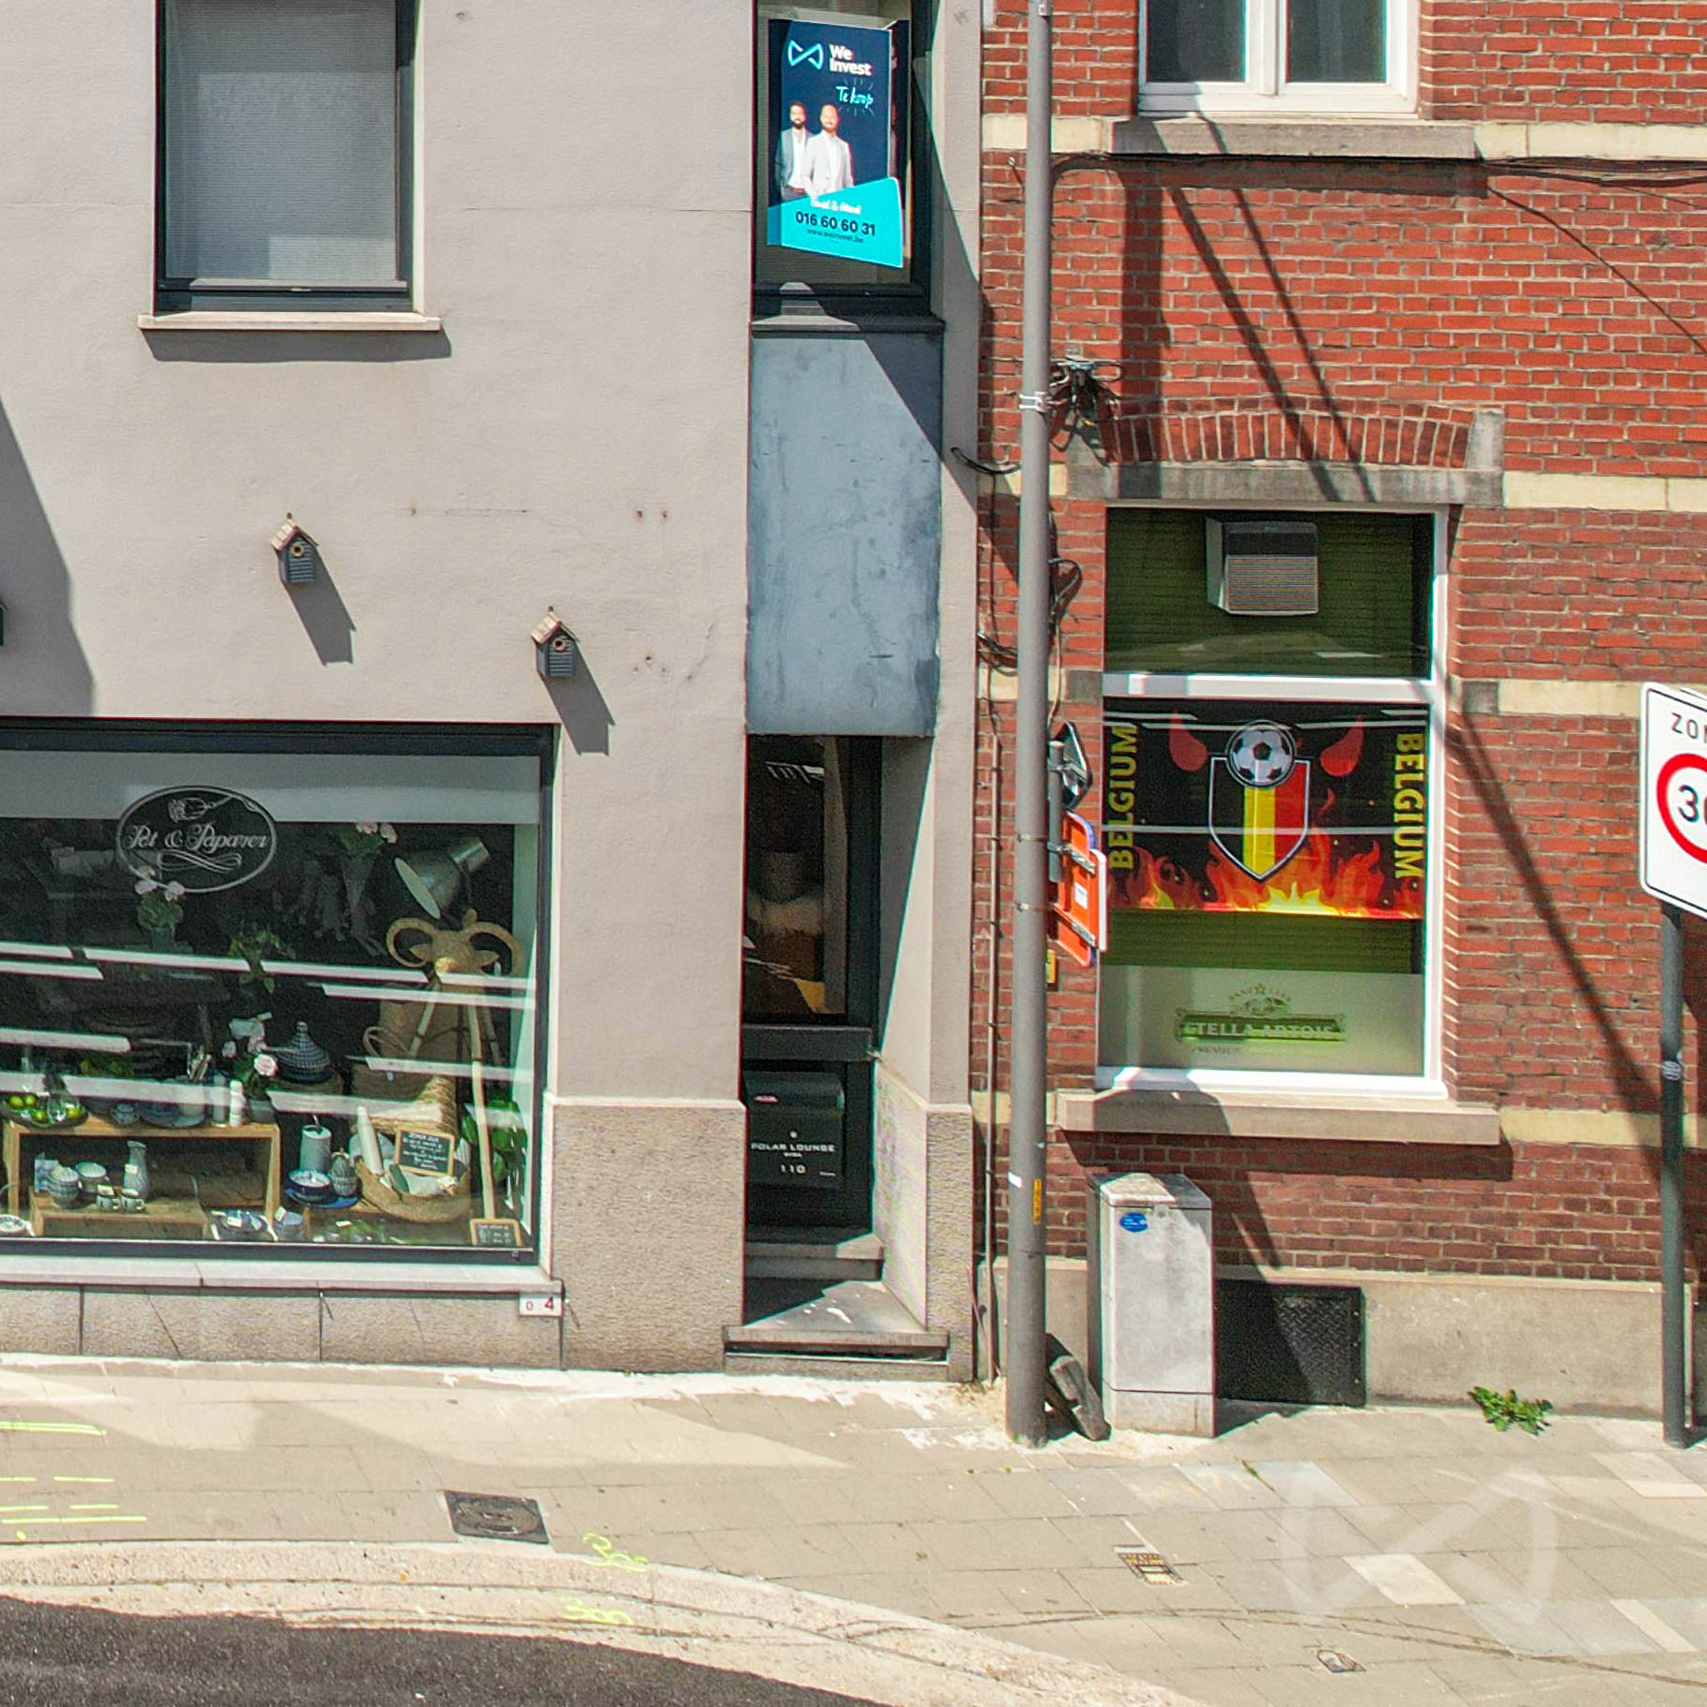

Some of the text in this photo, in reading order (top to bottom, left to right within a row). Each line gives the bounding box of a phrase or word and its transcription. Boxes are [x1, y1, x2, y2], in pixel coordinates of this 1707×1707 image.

[829, 44, 854, 60] We
[829, 58, 873, 76] Invest
[795, 211, 875, 236] 016 60 60 31
[1108, 726, 1138, 870] BELGIUM
[1393, 732, 1426, 879] BELGIUM
[1677, 783, 1707, 824] 3
[789, 1143, 836, 1153] LOUNGE
[780, 1164, 807, 1174] 110
[544, 1295, 554, 1310] 4
